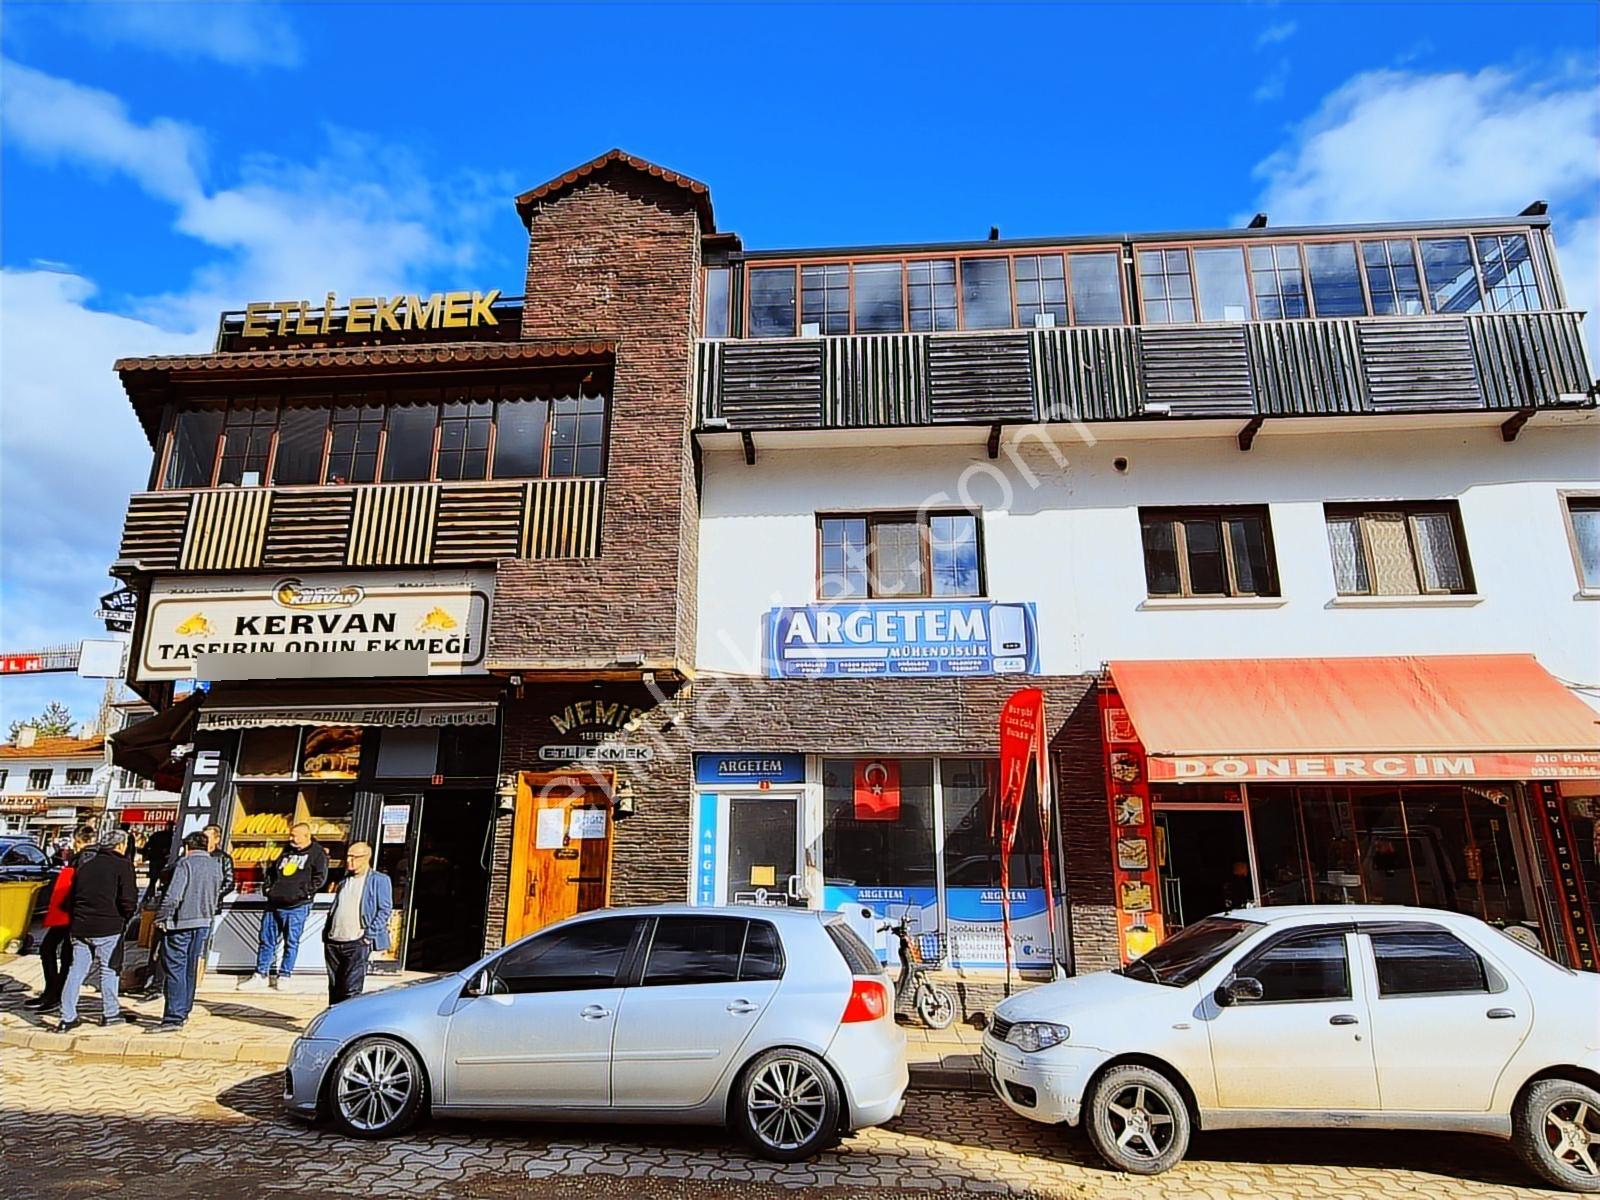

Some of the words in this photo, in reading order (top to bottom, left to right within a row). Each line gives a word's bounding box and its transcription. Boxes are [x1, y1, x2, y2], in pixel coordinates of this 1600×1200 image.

[345, 289, 502, 333] EKMEK
[290, 592, 357, 604] KERVAN
[234, 613, 396, 635] KERVAN
[784, 607, 987, 644] ARGETEM
[889, 644, 987, 658] MÜHENDİSLİK
[586, 747, 648, 759] EKMEK
[1563, 753, 1600, 763] Pake
[718, 760, 782, 771] ARGETEM
[1174, 754, 1477, 777] DÖNERCİM
[858, 890, 903, 898] ARGETEM
